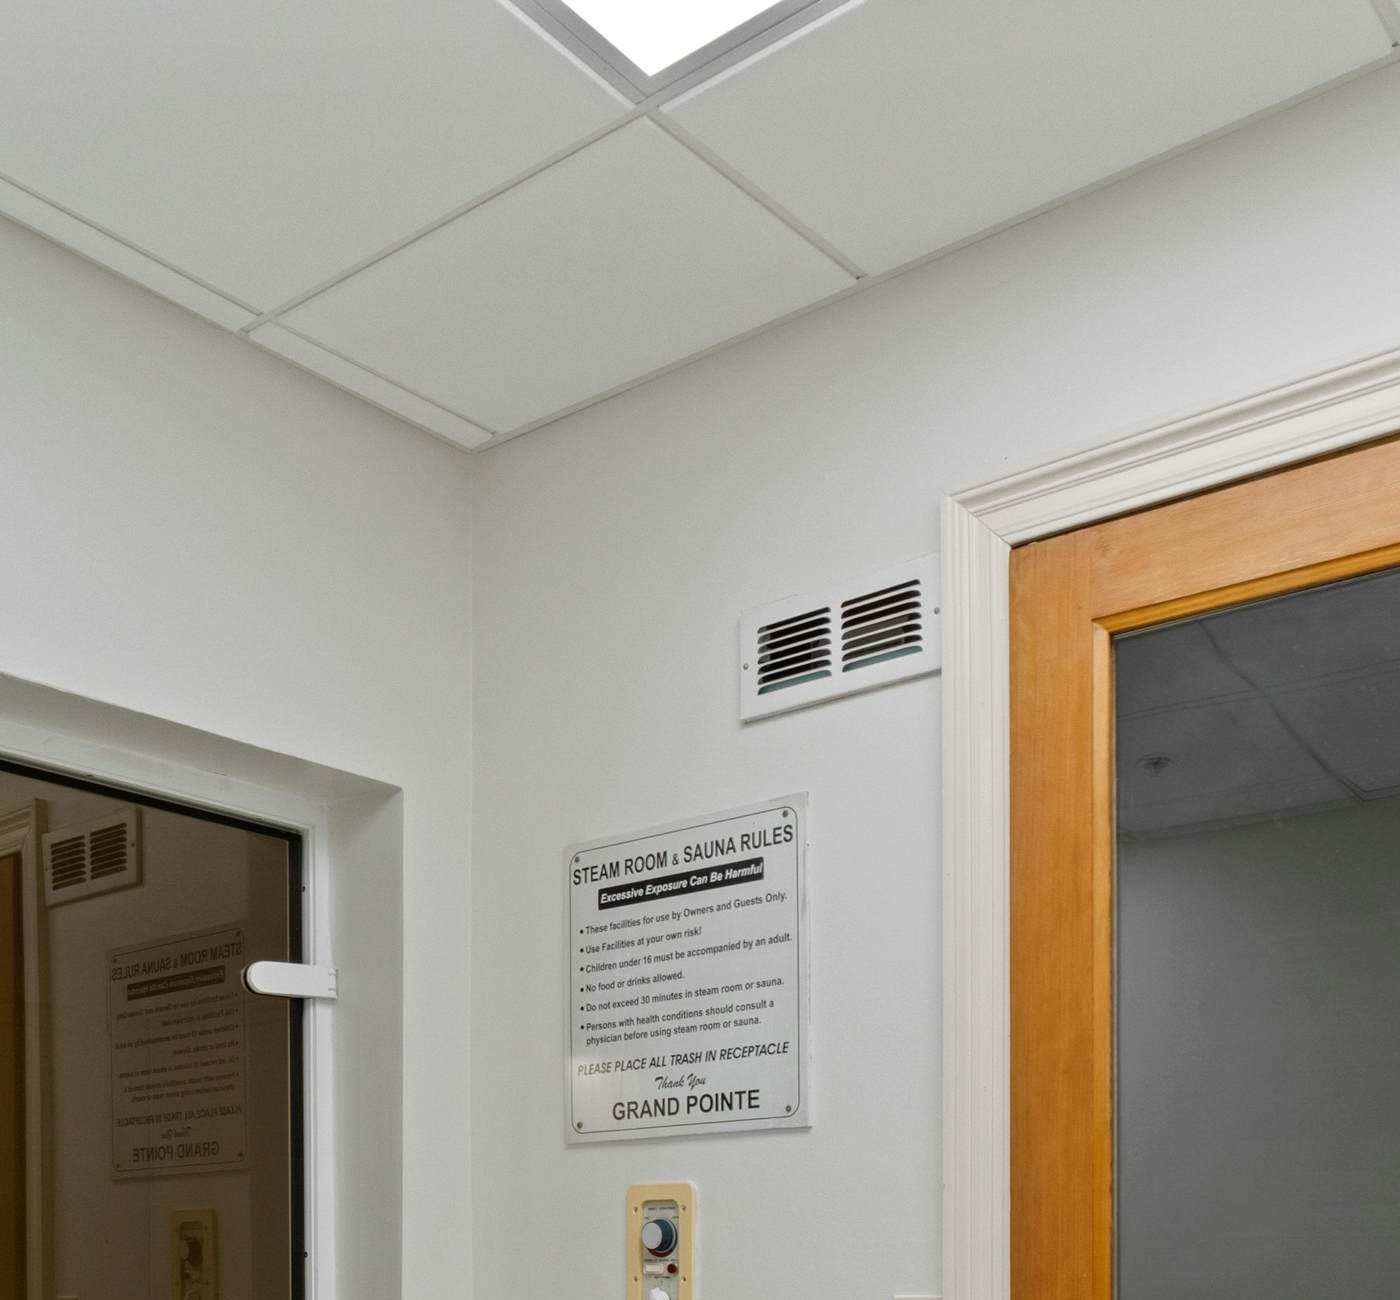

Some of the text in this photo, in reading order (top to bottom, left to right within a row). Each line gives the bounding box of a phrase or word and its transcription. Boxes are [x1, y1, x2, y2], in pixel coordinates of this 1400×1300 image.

[573, 824, 793, 885] STEAM ROOM & SAUNA RULES
[600, 862, 763, 904] Excessive Exposure Can Be Harmful
[585, 924, 608, 935] These
[610, 917, 641, 930] facilities
[643, 915, 654, 924] for
[656, 914, 669, 922] use
[672, 911, 681, 921] by
[683, 904, 714, 917] Owners
[716, 902, 732, 912] and
[733, 896, 763, 909] Guests
[585, 926, 702, 954] Use Facilities at your own risk!
[586, 932, 792, 973] Children under 16 must be accompanied by an adult.
[586, 970, 685, 992] No food or drinks allowed.
[586, 977, 784, 1012] Do not exceed 30 minutes in steam room or sauna.
[586, 1000, 774, 1031] Persons with health conditions should consult a
[586, 1016, 761, 1047] physician before using steam room or sauna.
[577, 1041, 790, 1076] PLEASE PLACE ALL TRASH IN RECEPTACLE
[655, 1073, 707, 1091] Thank You
[612, 1089, 760, 1121] GRAND POINTE
